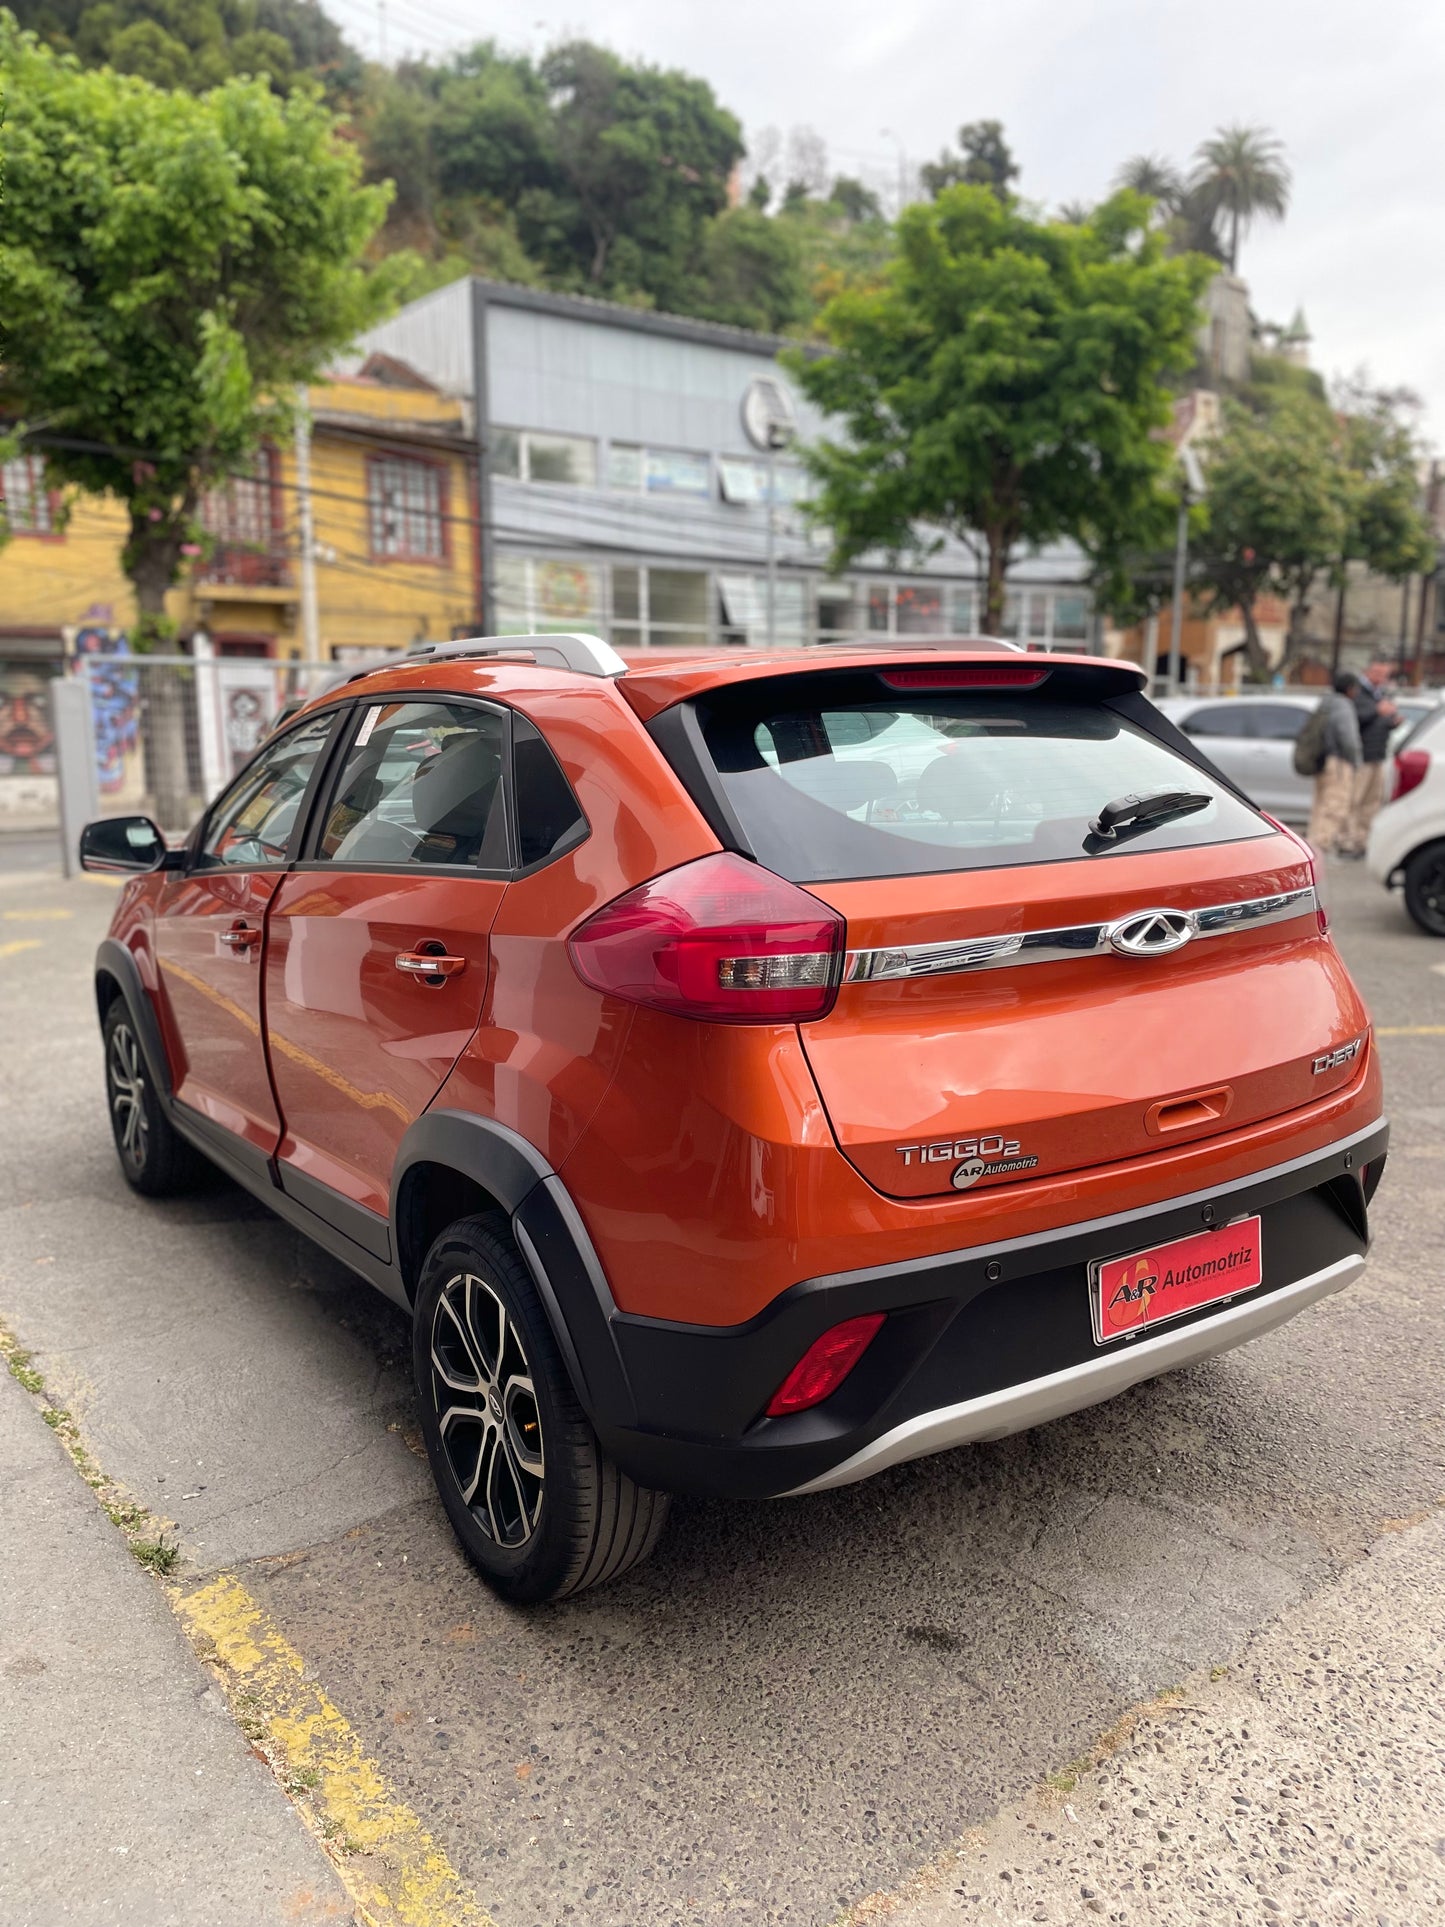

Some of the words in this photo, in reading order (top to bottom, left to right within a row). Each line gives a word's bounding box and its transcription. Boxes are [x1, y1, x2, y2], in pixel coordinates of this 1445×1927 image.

[1312, 1039, 1361, 1075] CHERY
[955, 1166, 983, 1179] AR
[983, 1157, 1039, 1176] Automotriz
[1108, 1275, 1158, 1309] A&R
[1162, 1246, 1253, 1290] Automotriz
